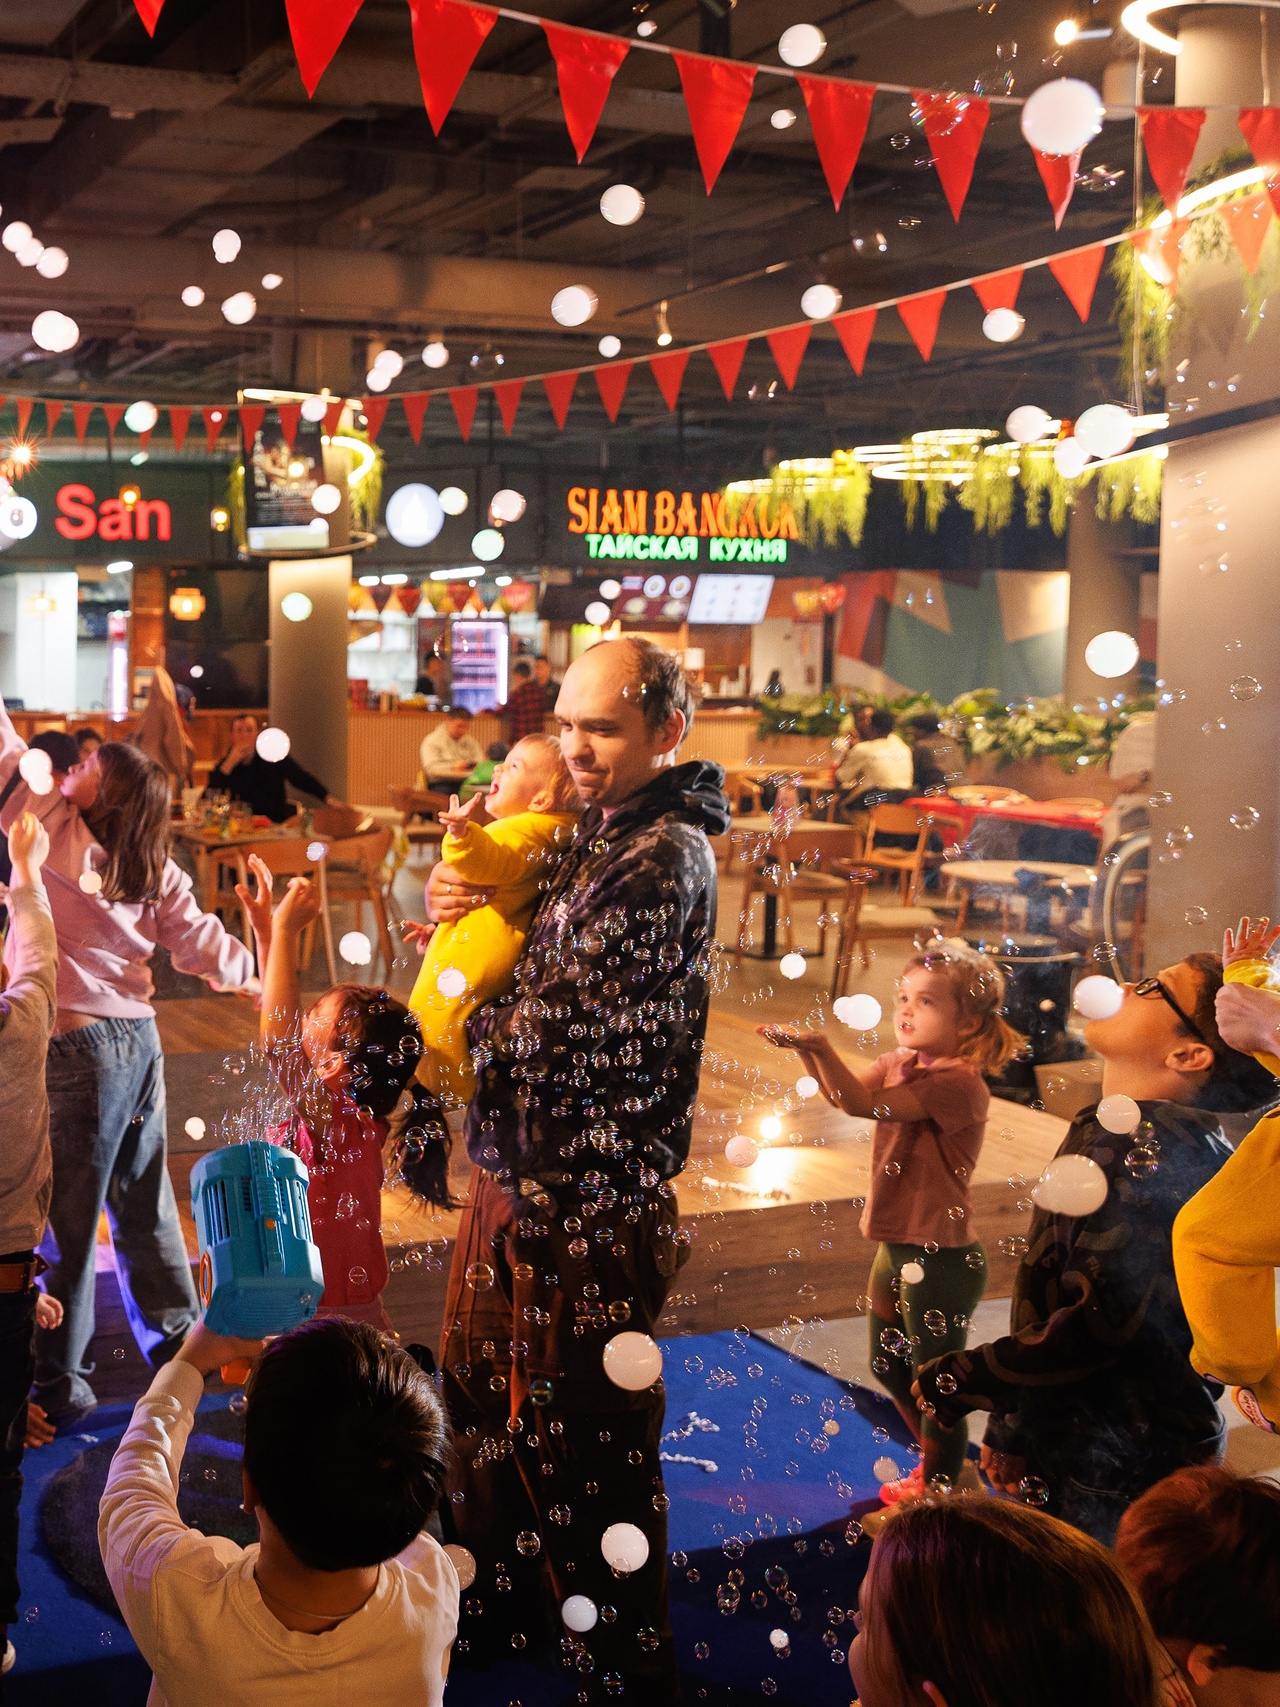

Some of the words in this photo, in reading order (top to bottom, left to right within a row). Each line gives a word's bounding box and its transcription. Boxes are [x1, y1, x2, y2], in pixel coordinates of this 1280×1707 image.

[55, 483, 171, 540] San
[568, 487, 649, 535] SIAM
[585, 533, 699, 561] ТАЙСКАЯ
[709, 535, 788, 563] КУХНЯ
